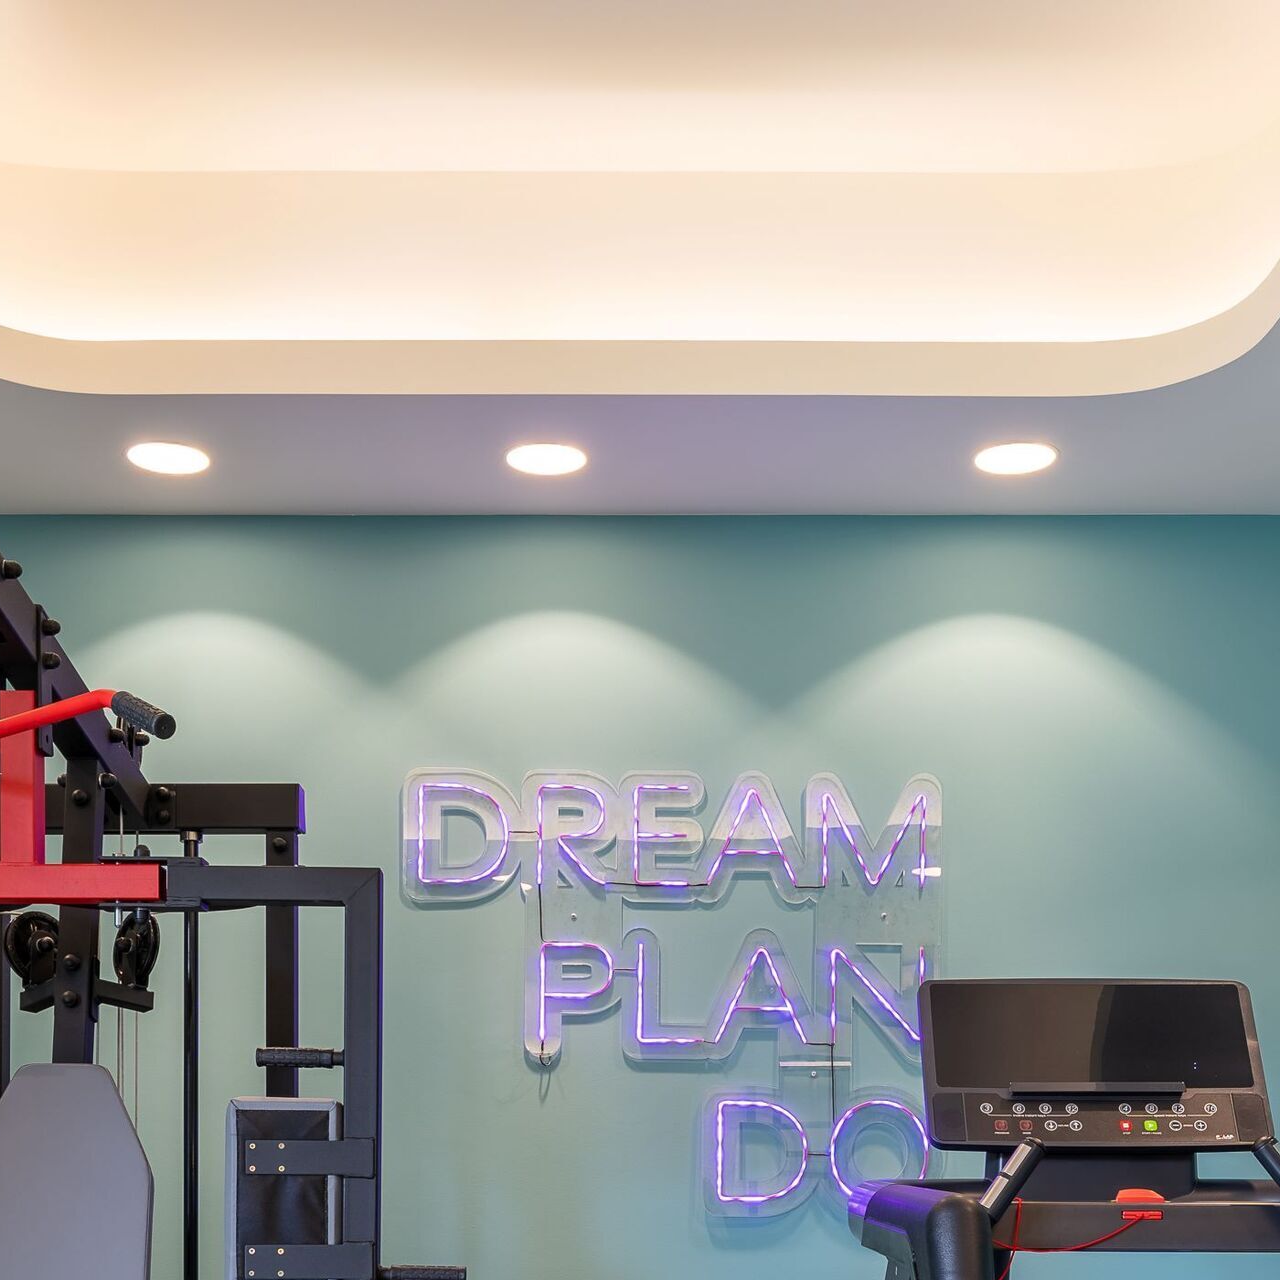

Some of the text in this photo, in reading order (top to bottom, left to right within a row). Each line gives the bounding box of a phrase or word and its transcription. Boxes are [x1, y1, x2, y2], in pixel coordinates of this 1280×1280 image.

[417, 780, 928, 889] DREAM
[539, 940, 926, 1046] PLAN
[717, 1098, 930, 1204] DO
